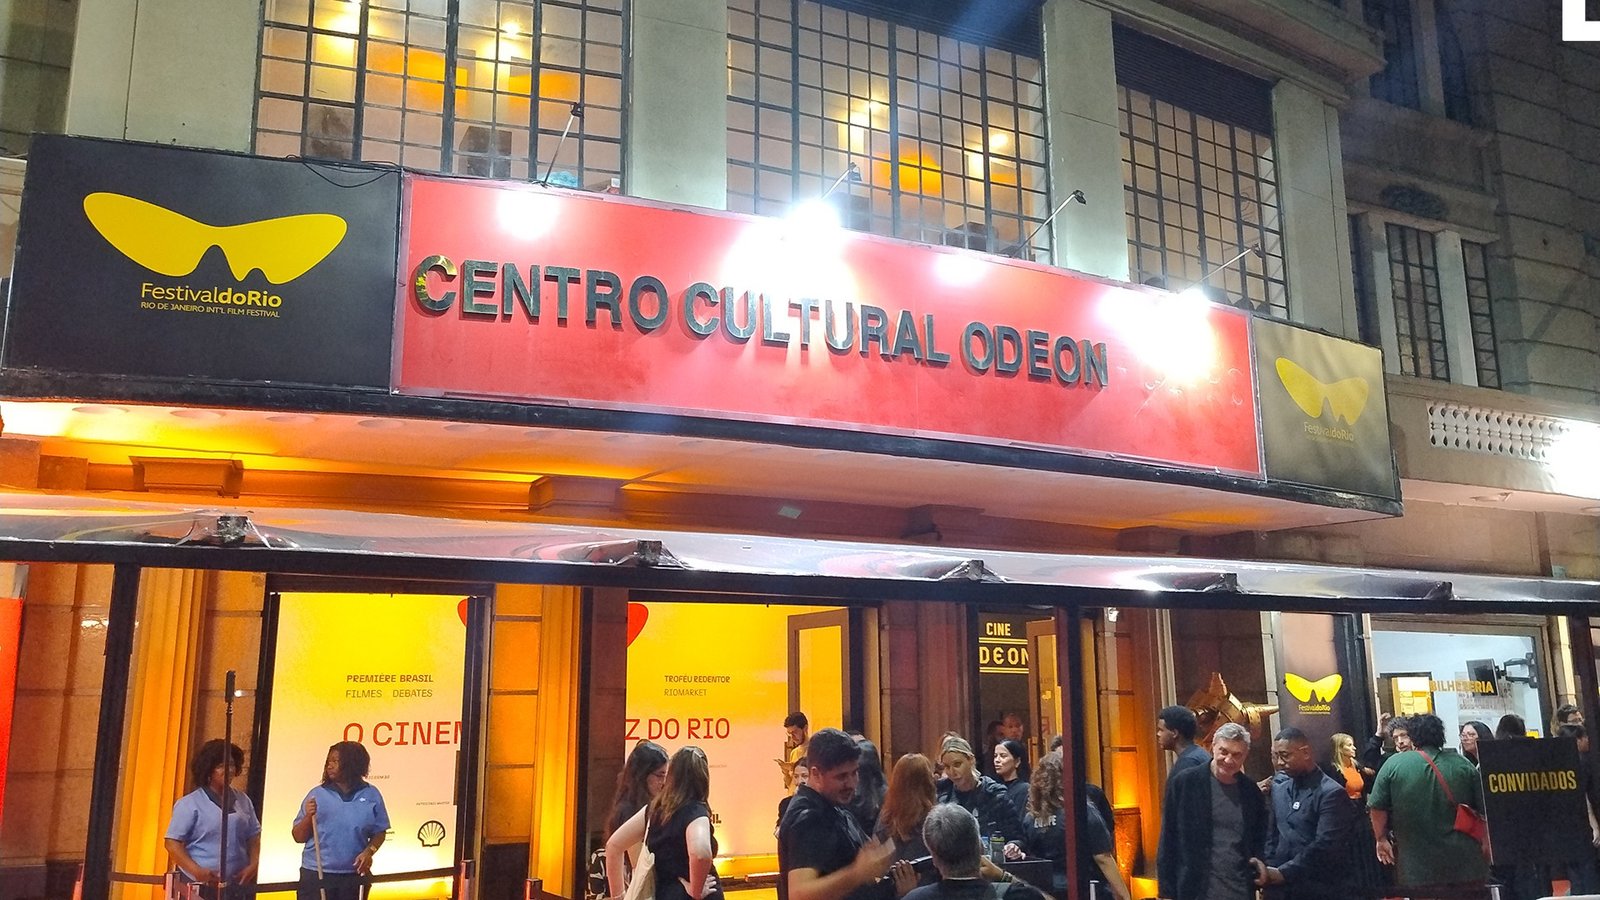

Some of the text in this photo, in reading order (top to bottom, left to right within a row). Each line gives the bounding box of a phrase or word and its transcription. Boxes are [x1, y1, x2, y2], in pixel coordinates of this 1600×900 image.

[141, 282, 282, 308] FestivaldoRio
[140, 301, 281, 318] RIO DE JANEIRO INT'L FILM FESTIVAL
[414, 254, 1109, 387] CENTRO CULTURAL ODEON
[986, 622, 1011, 636] CINE
[399, 674, 434, 683] BRASIL
[664, 673, 731, 684] TROFÉU REDENTOR
[345, 689, 433, 698] FILMES DEBATES
[663, 688, 707, 697] RIOMARKET
[343, 722, 364, 743] O
[648, 718, 680, 740] DO
[687, 717, 730, 739] RIO
[1488, 769, 1577, 793] CONVIDADOS
